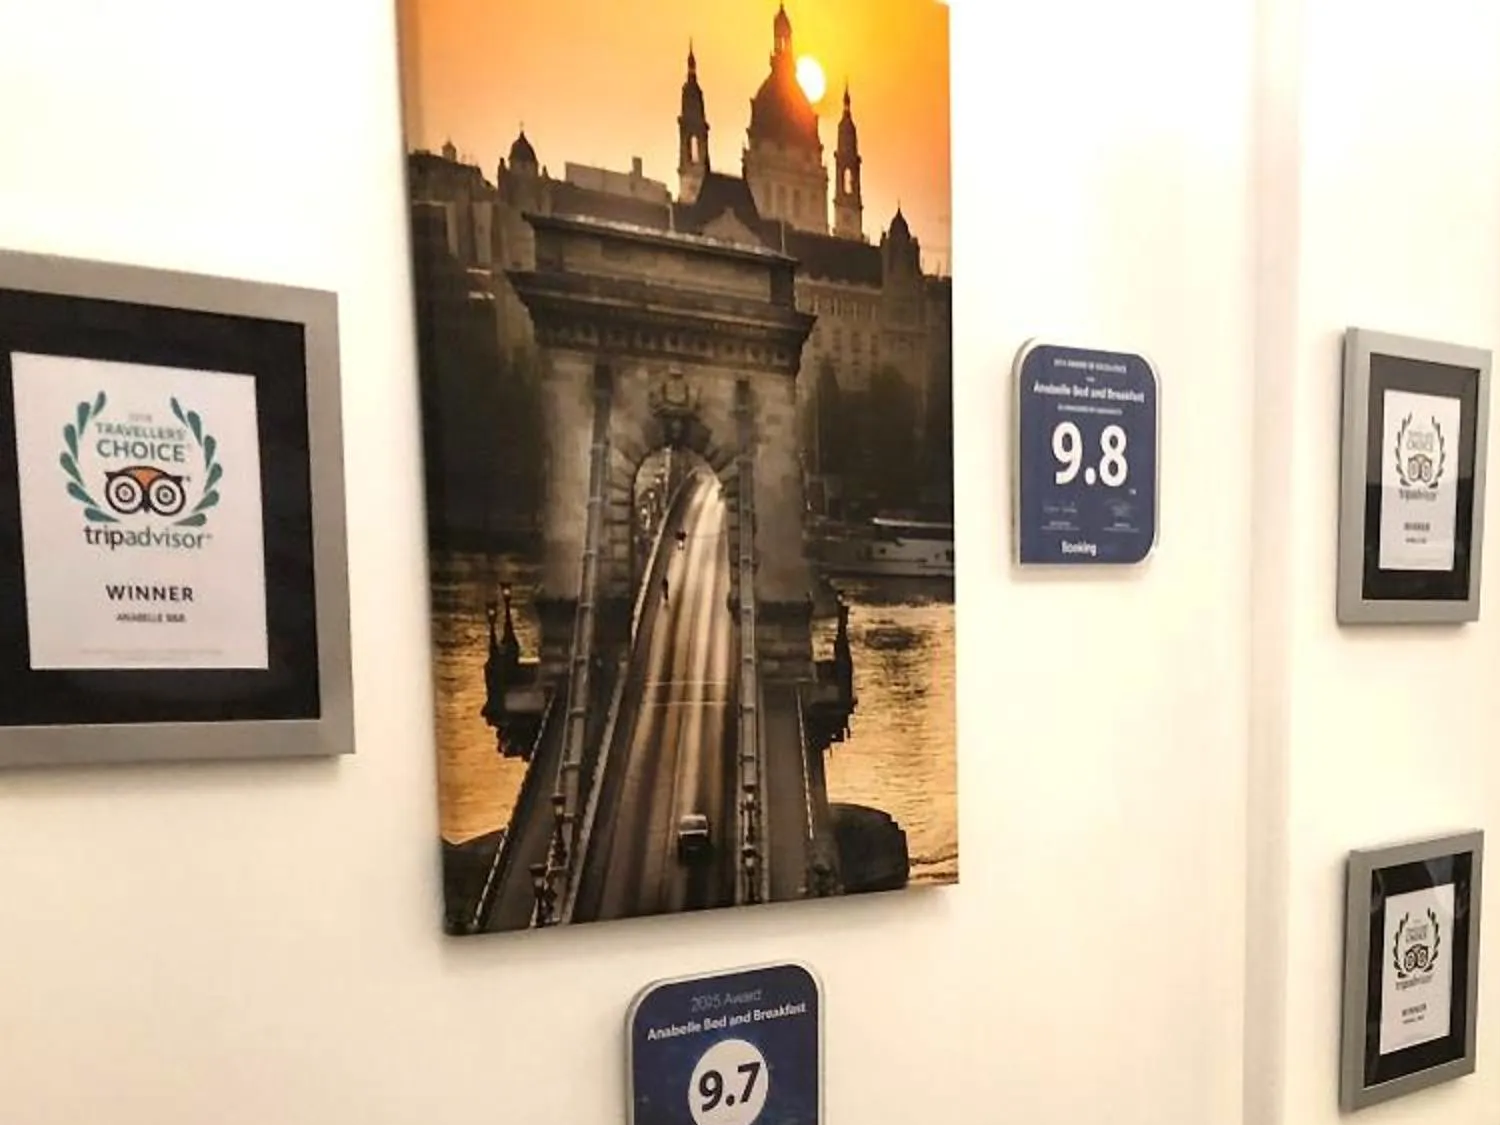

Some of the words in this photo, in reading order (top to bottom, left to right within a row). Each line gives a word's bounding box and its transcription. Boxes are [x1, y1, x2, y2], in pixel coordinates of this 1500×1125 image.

[1072, 384, 1089, 398] Bed
[1091, 387, 1107, 399] and
[1107, 387, 1145, 403] Breakfast
[96, 438, 186, 463] CHOICE
[1052, 421, 1128, 487] 9.8
[83, 525, 204, 551] tripadvisor
[1060, 540, 1098, 557] Booking
[105, 584, 194, 602] WINNER
[647, 1021, 701, 1041] Anabelle
[703, 1015, 727, 1031] Bed
[729, 1011, 751, 1027] and
[753, 1002, 807, 1021] Breakfast
[699, 1061, 761, 1113] 9.7
